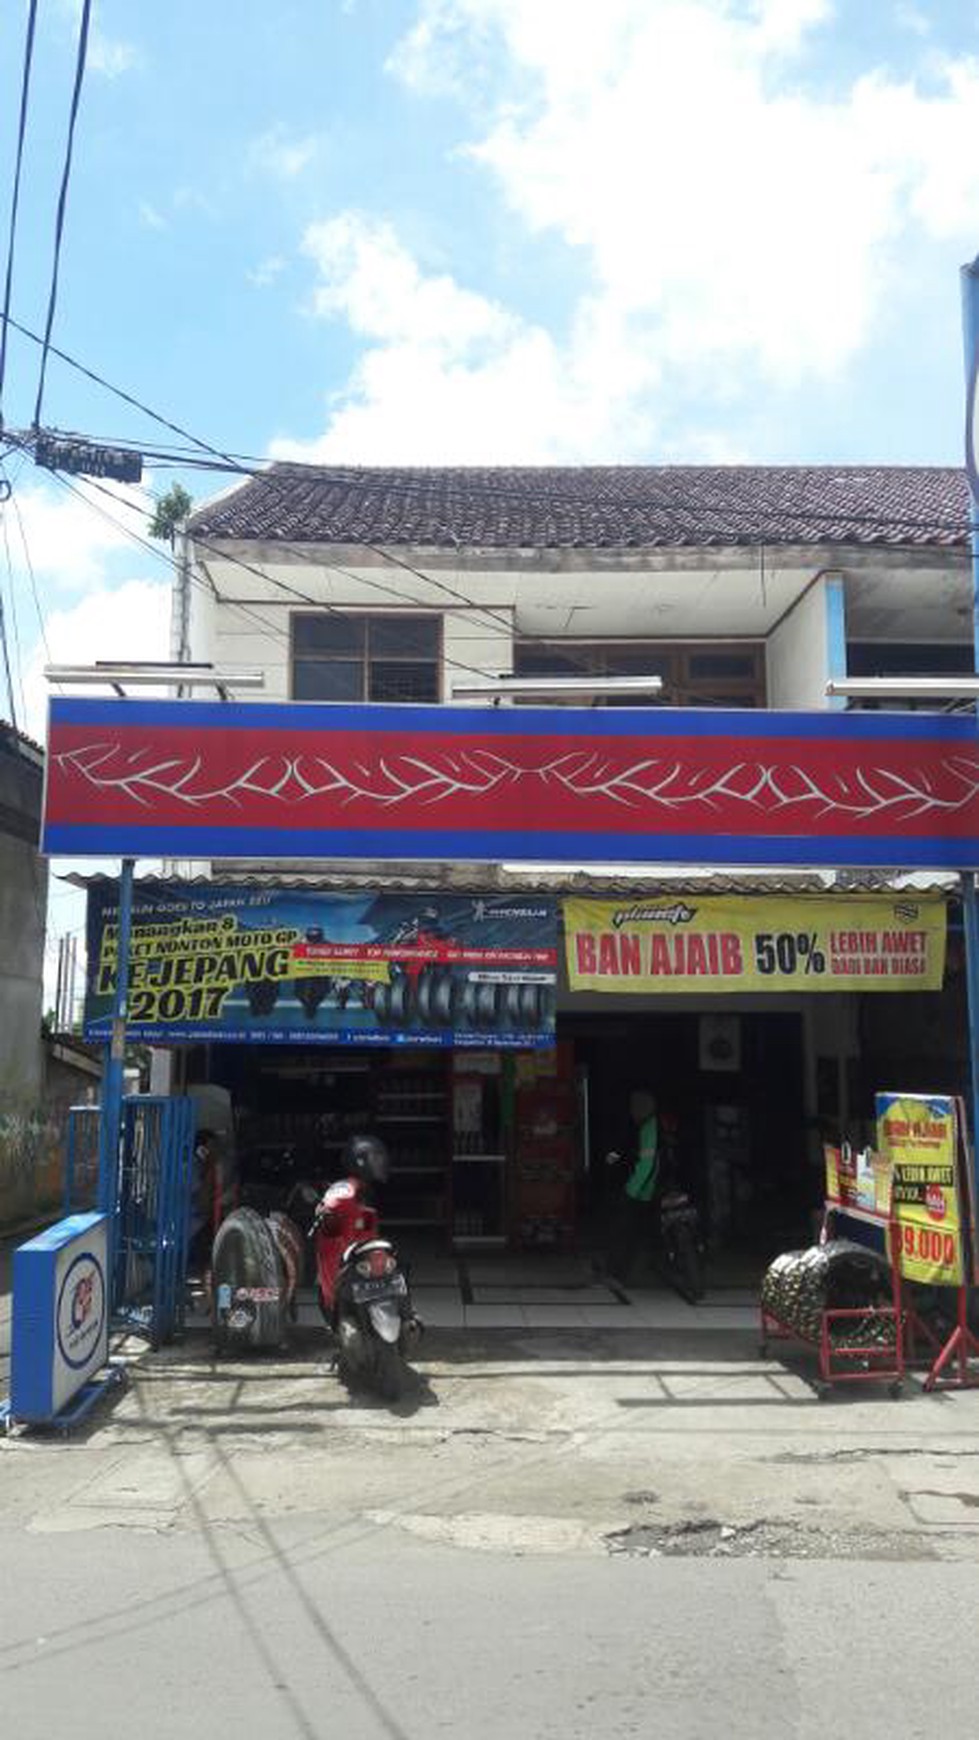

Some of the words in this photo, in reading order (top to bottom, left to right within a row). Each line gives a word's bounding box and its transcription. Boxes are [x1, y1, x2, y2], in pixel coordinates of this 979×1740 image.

[104, 919, 218, 938] Mnangkan
[156, 935, 221, 955] NONTON
[225, 932, 272, 949] MOTO
[275, 930, 297, 944] GP
[830, 931, 878, 953] LEBIH
[881, 931, 927, 953] AWET
[150, 949, 289, 987] JEPANG
[576, 932, 641, 975] BAN
[650, 932, 743, 975] AJAIB
[755, 933, 826, 975] 50%
[131, 986, 229, 1020] 2017
